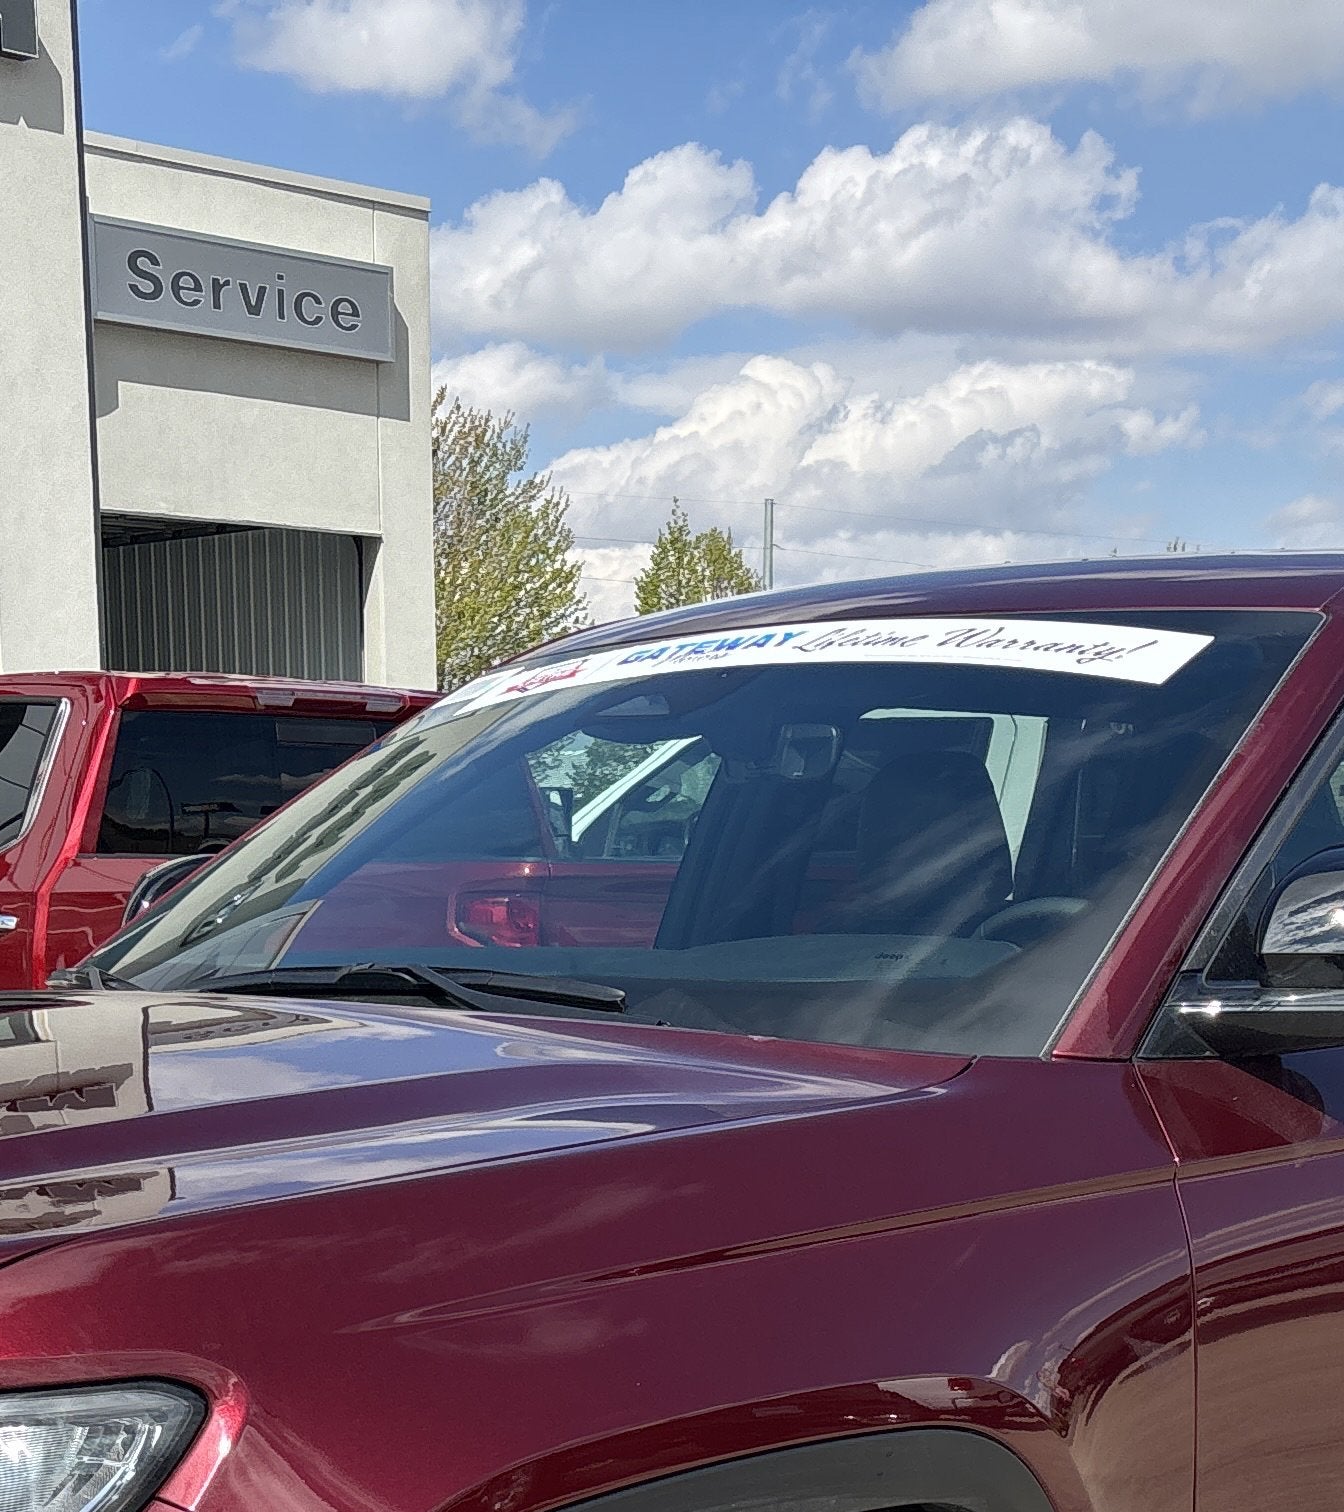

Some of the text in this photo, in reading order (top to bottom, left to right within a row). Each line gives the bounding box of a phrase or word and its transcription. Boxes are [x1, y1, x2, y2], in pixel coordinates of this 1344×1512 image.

[126, 249, 361, 333] Service
[617, 626, 1159, 666] GATEWAY Lifetime Warranty!
